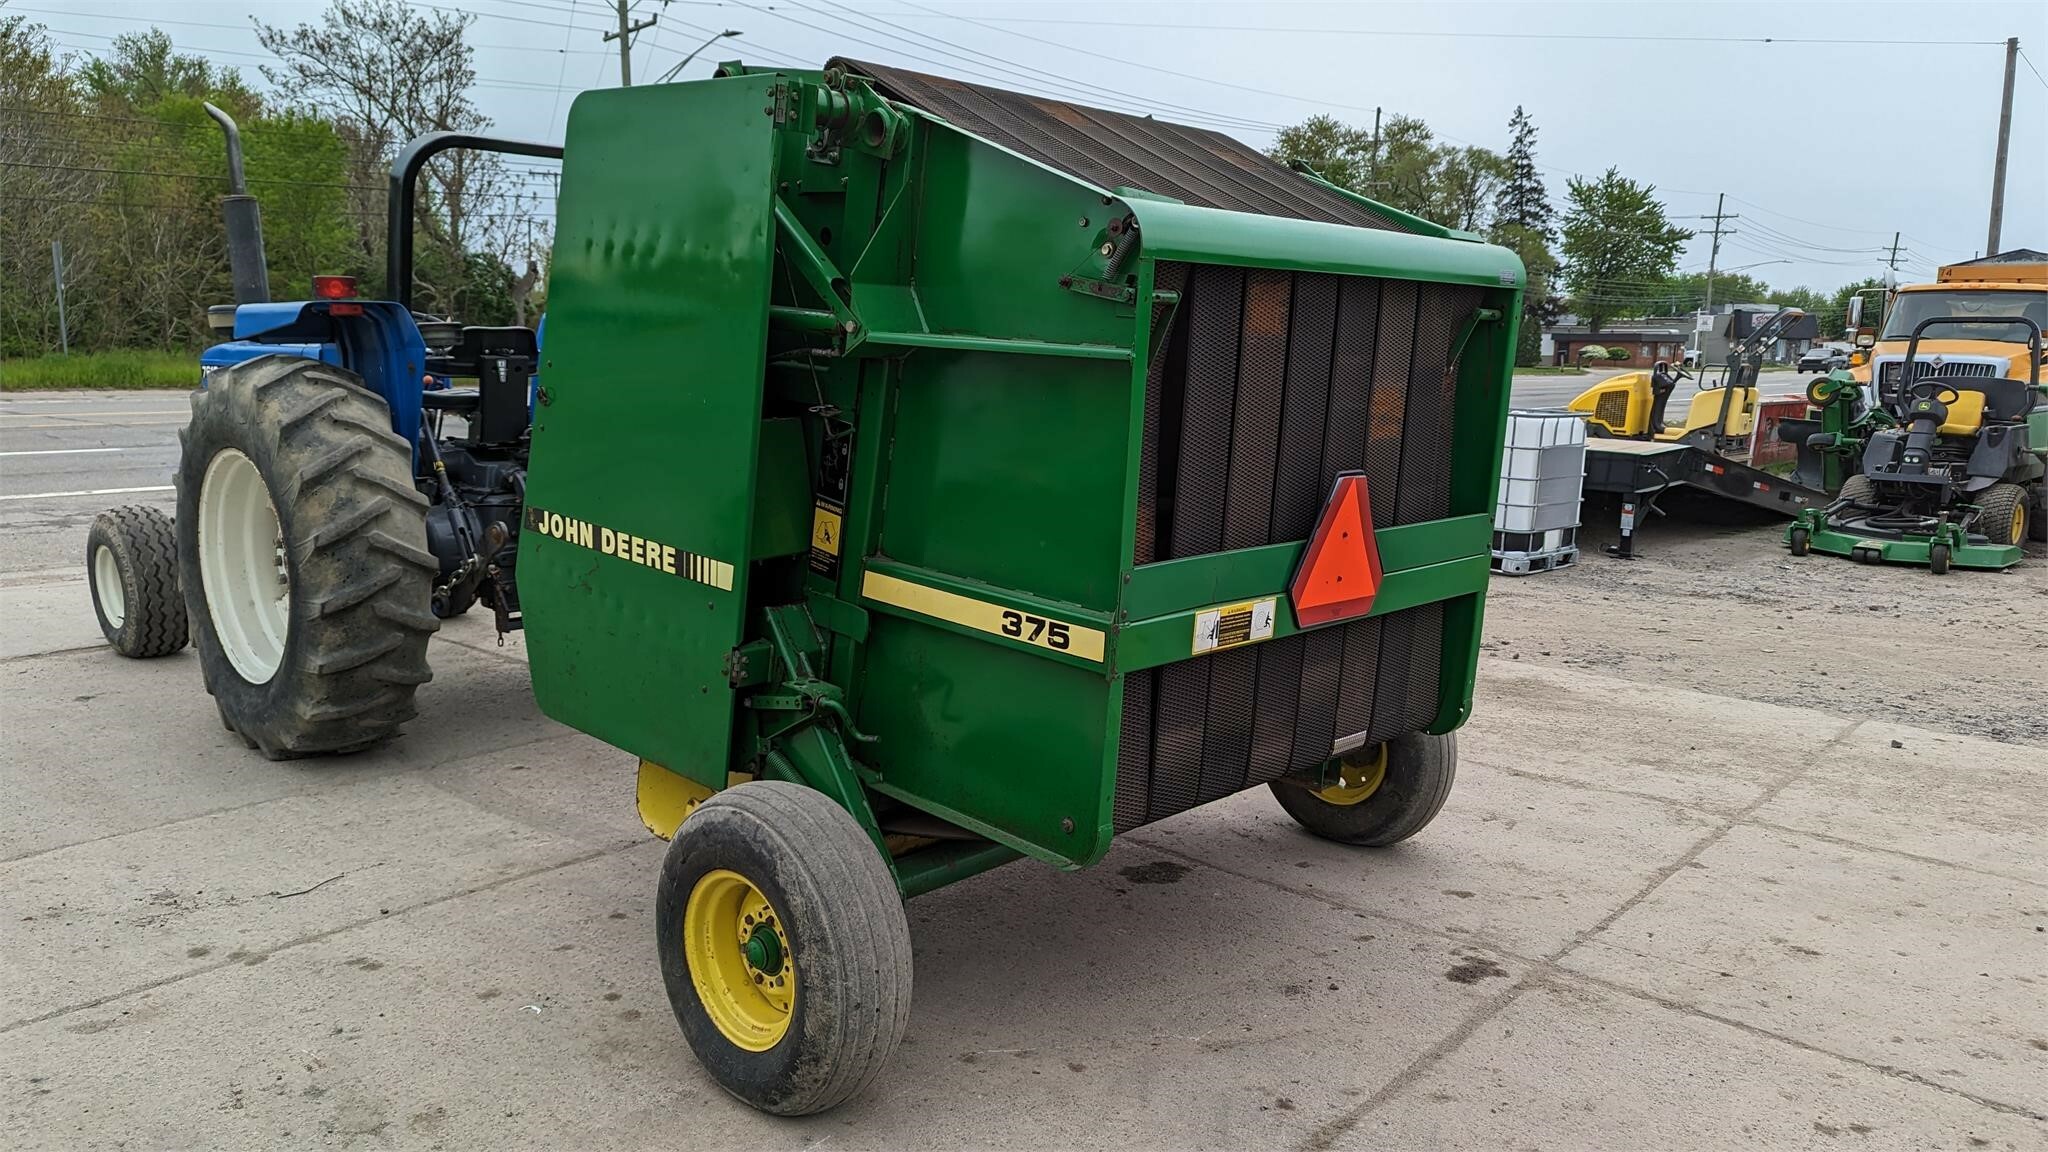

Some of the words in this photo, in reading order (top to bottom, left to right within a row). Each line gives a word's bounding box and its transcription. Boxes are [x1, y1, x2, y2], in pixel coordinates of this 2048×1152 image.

[538, 510, 593, 549] JOHN
[600, 527, 676, 575] DEERE
[1001, 610, 1070, 650] 375
